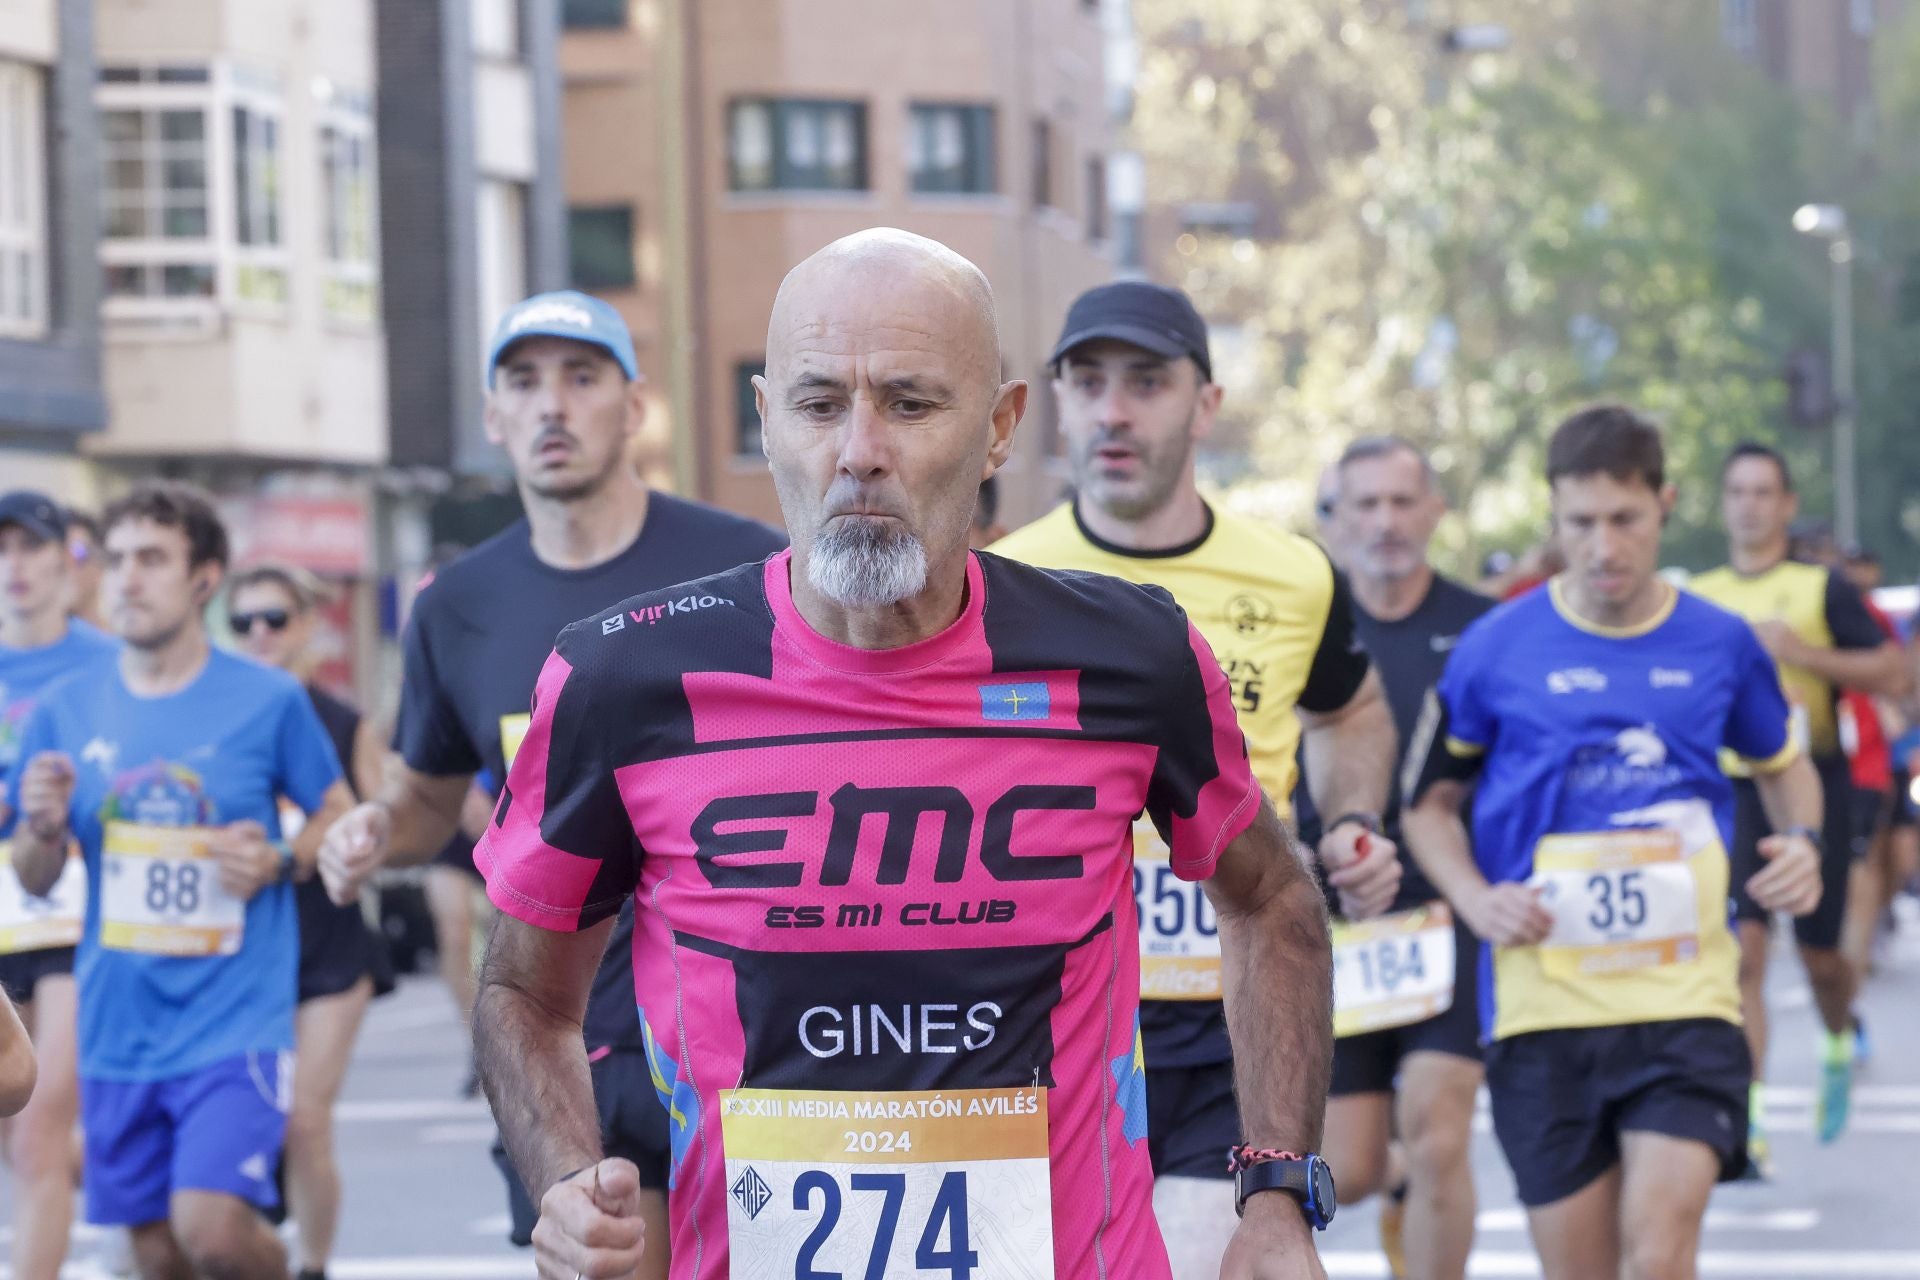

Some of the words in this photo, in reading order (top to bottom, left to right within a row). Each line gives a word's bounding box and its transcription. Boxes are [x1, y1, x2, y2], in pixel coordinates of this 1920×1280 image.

[147, 863, 199, 913] 88
[1588, 872, 1646, 929] 35
[765, 905, 825, 928] ES
[835, 902, 882, 927] MI
[900, 899, 1017, 926] CLUB
[1359, 941, 1425, 989] 184
[798, 1001, 1003, 1058] GINES
[788, 1099, 850, 1119] MEDIA
[854, 1094, 962, 1119] MARATÓN
[967, 1090, 1039, 1116] AVILÉS
[844, 1130, 912, 1153] 2024
[793, 1170, 979, 1280] 274
